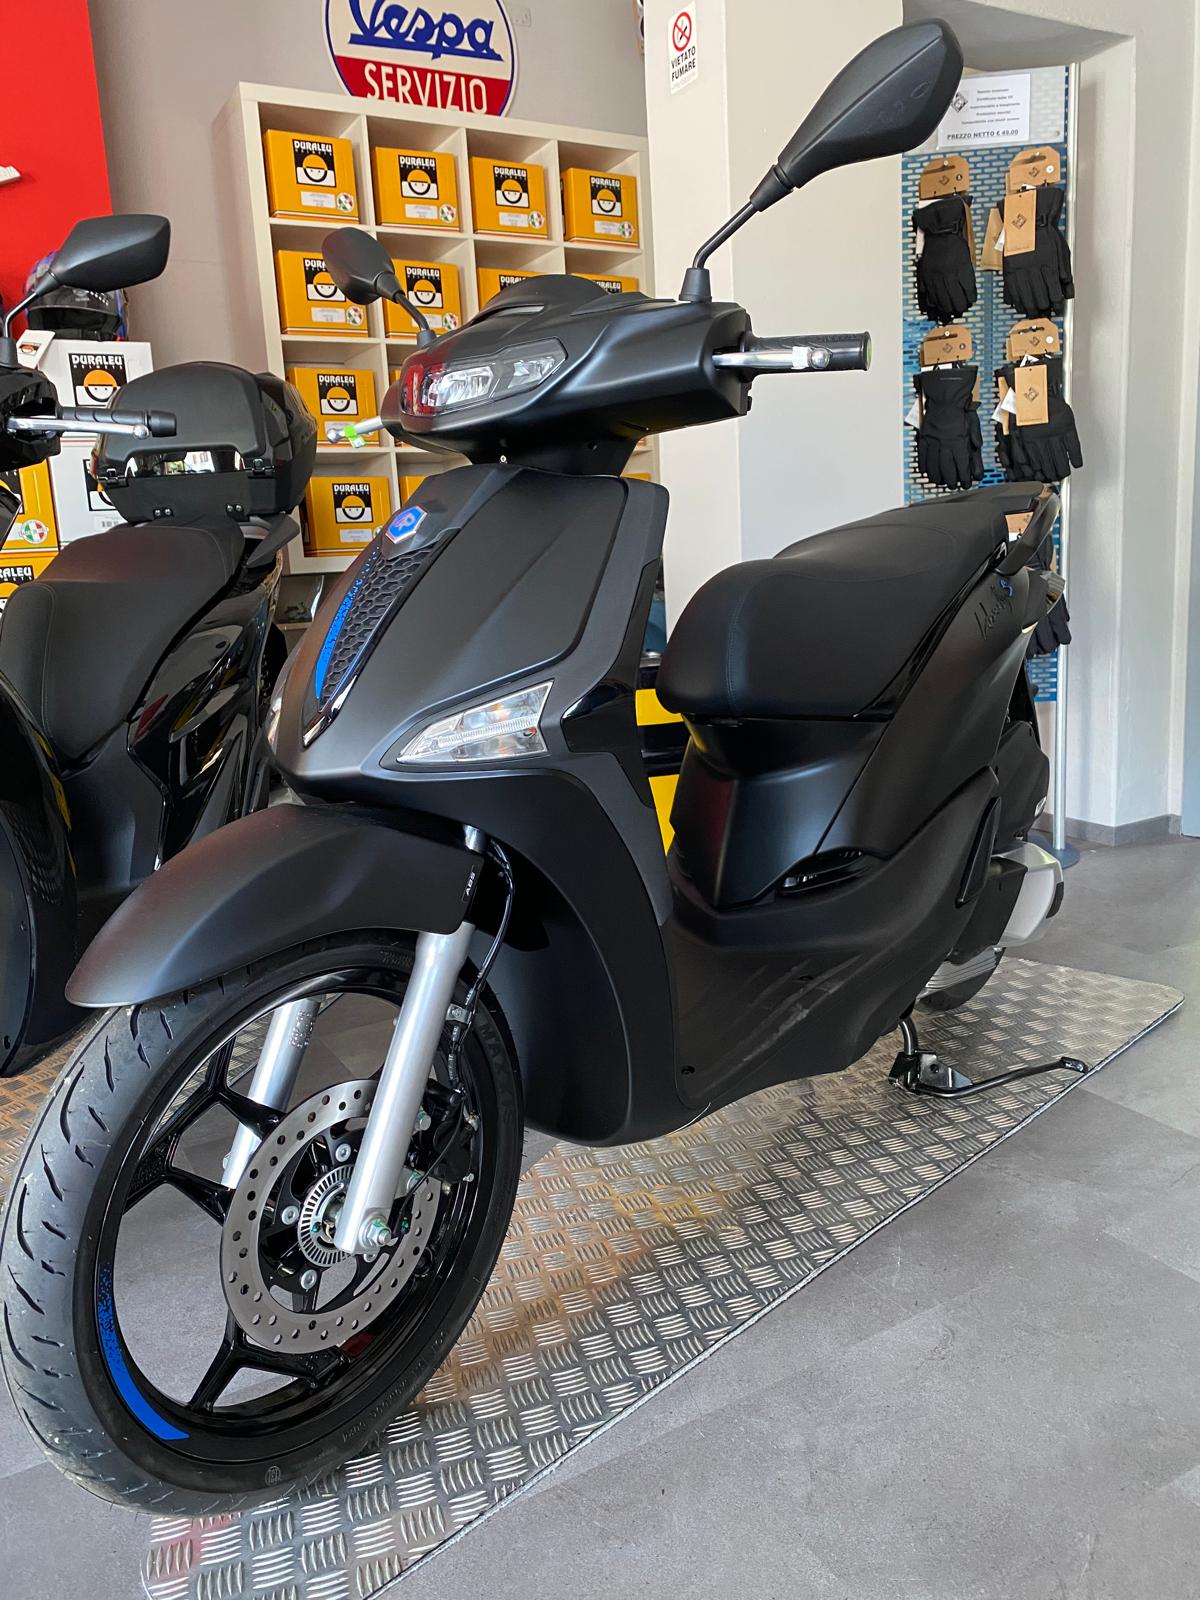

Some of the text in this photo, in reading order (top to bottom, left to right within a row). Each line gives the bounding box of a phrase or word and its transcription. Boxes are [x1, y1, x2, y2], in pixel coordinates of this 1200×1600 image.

[347, 0, 504, 60] Vespa
[671, 45, 696, 69] VIETATO
[671, 58, 696, 82] FUMARE
[364, 63, 488, 115] SERVIZIO
[947, 132, 972, 140] PREZZO
[973, 130, 995, 138] NETTO
[293, 141, 332, 153] DURALEU
[399, 156, 436, 168] DURALEU
[494, 166, 527, 179] DURALEU
[590, 177, 621, 188] DURALEU
[406, 267, 440, 277] DURALEU
[71, 354, 123, 366] DURALEU
[319, 375, 355, 384] DURALEU
[333, 484, 370, 492] DURALEU
[0, 566, 32, 578] ALEU
